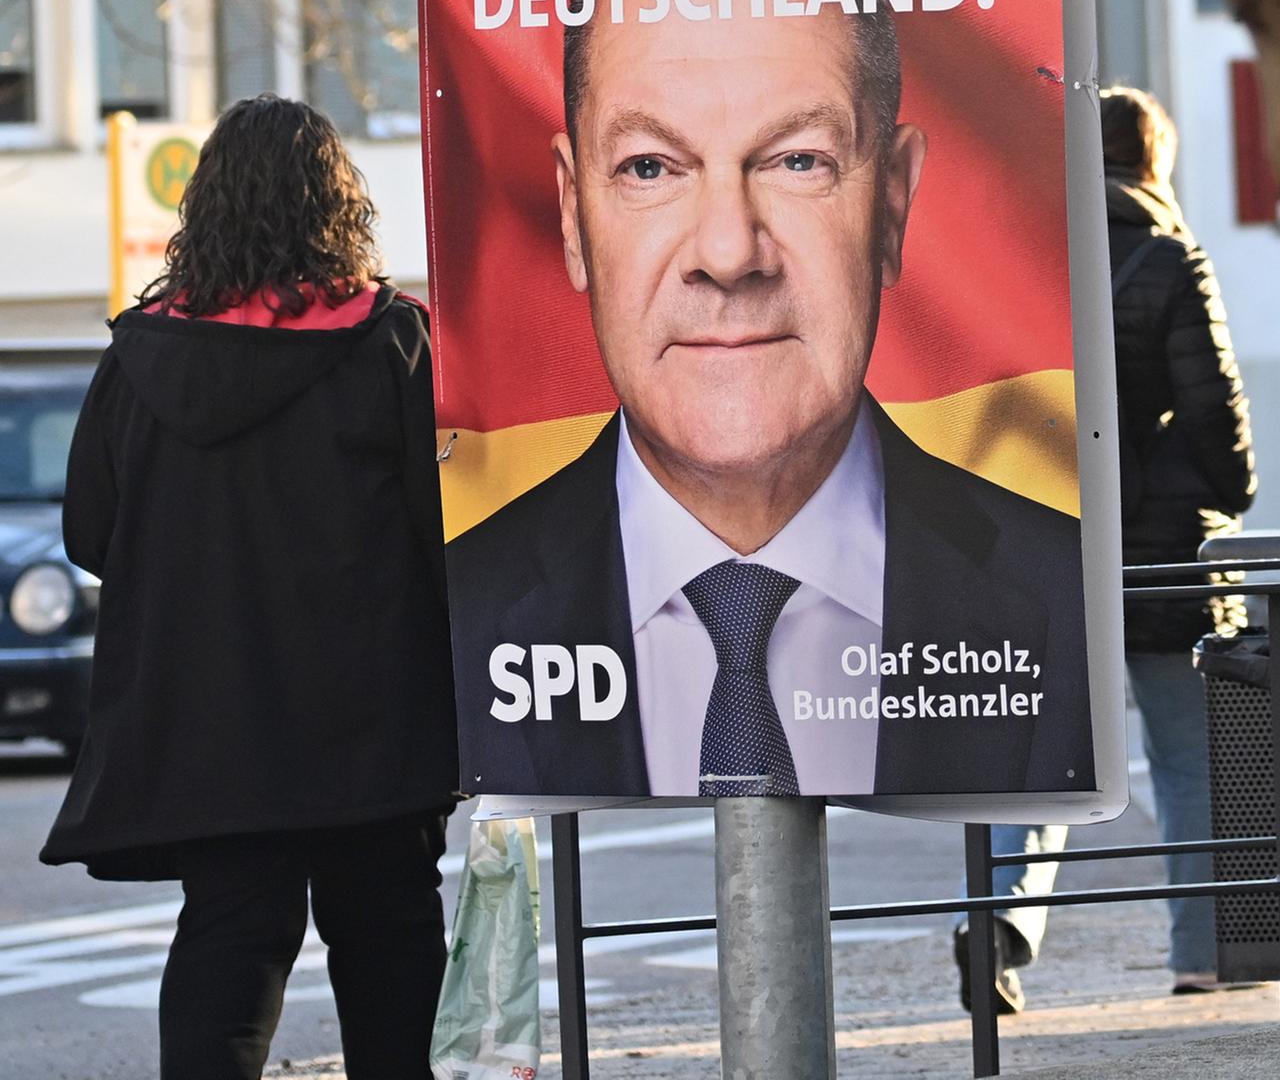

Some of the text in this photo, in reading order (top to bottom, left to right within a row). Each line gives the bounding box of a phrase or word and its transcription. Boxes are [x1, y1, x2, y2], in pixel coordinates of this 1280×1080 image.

[841, 639, 1042, 679] Olaf Scholz,
[488, 643, 628, 723] SPD
[793, 684, 1044, 721] Bundeskanzler
